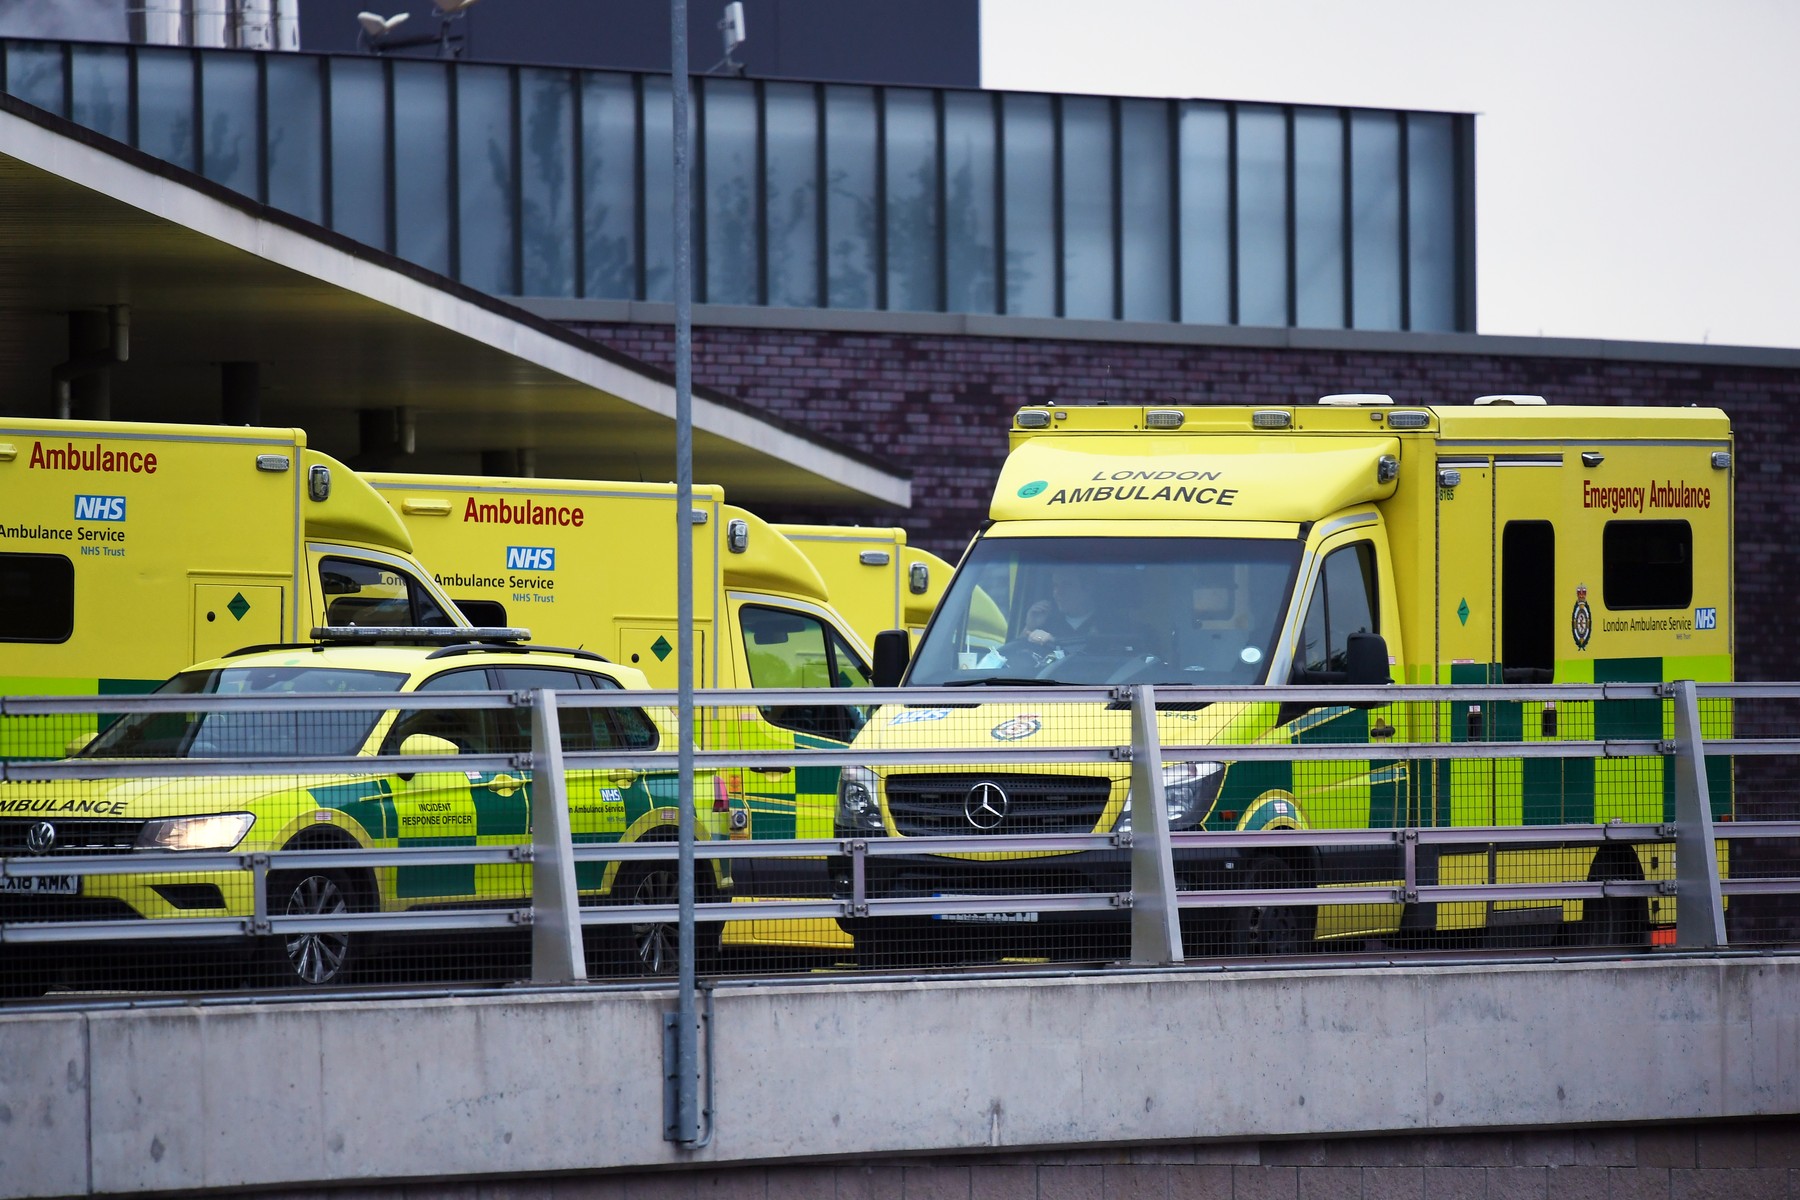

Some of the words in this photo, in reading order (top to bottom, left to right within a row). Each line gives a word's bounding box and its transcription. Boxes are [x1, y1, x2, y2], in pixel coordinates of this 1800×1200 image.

[29, 441, 158, 474] Ambulance
[1091, 470, 1222, 481] LONDON
[1047, 485, 1239, 506] AMBULANCE
[1583, 479, 1645, 514] Emergency
[1649, 479, 1711, 509] Ambulance
[75, 495, 125, 520] NHS
[464, 497, 585, 527] Ambulance
[0, 524, 73, 540] Ambulance
[77, 527, 125, 542] Service
[80, 545, 100, 556] NHS
[103, 546, 126, 557] Trust
[507, 547, 554, 570] NHS
[433, 573, 506, 588] Ambulance
[509, 575, 555, 590] Service
[512, 592, 531, 602] NHS
[532, 593, 555, 603] Trust
[1603, 617, 1629, 632] London
[1630, 617, 1667, 631] Ambulance
[1668, 616, 1692, 630] Service
[1695, 608, 1716, 629] NHS
[601, 789, 621, 802] NHS
[418, 803, 452, 812] INCIDENT
[574, 805, 604, 813] Ambulance
[605, 804, 625, 813] Service
[402, 816, 440, 826] RESPONSE
[442, 815, 472, 825] OFFICER
